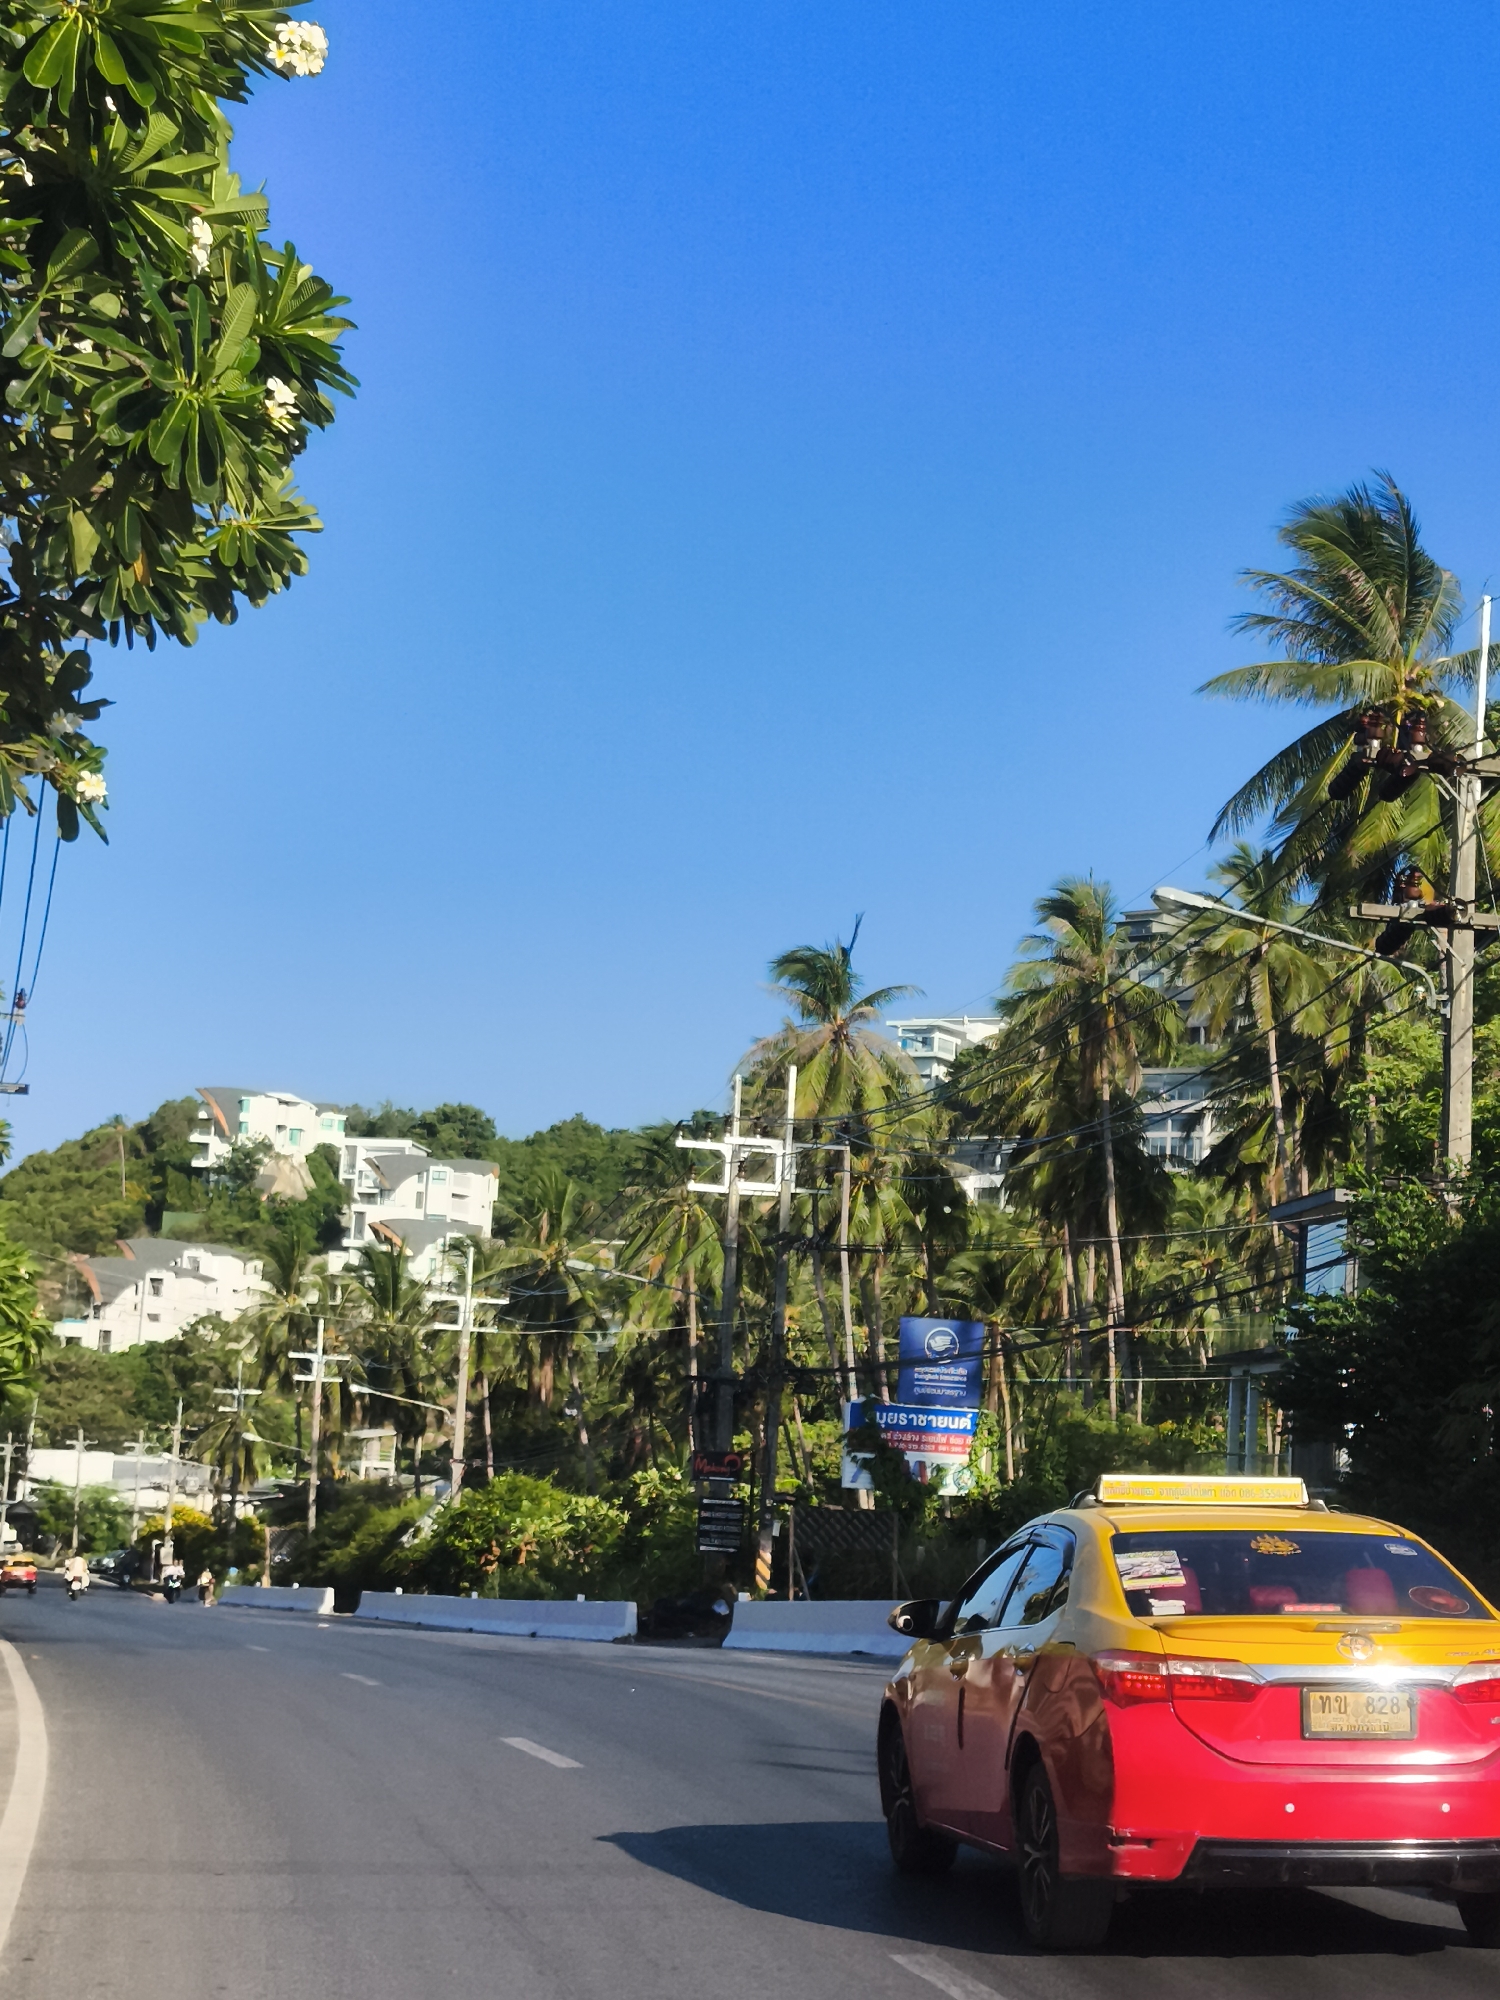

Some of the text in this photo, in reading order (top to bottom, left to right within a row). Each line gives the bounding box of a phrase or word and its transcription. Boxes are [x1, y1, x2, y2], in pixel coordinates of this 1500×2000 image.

[868, 1411, 972, 1430] มุยราชายนต์
[1365, 1696, 1400, 1715] 828
